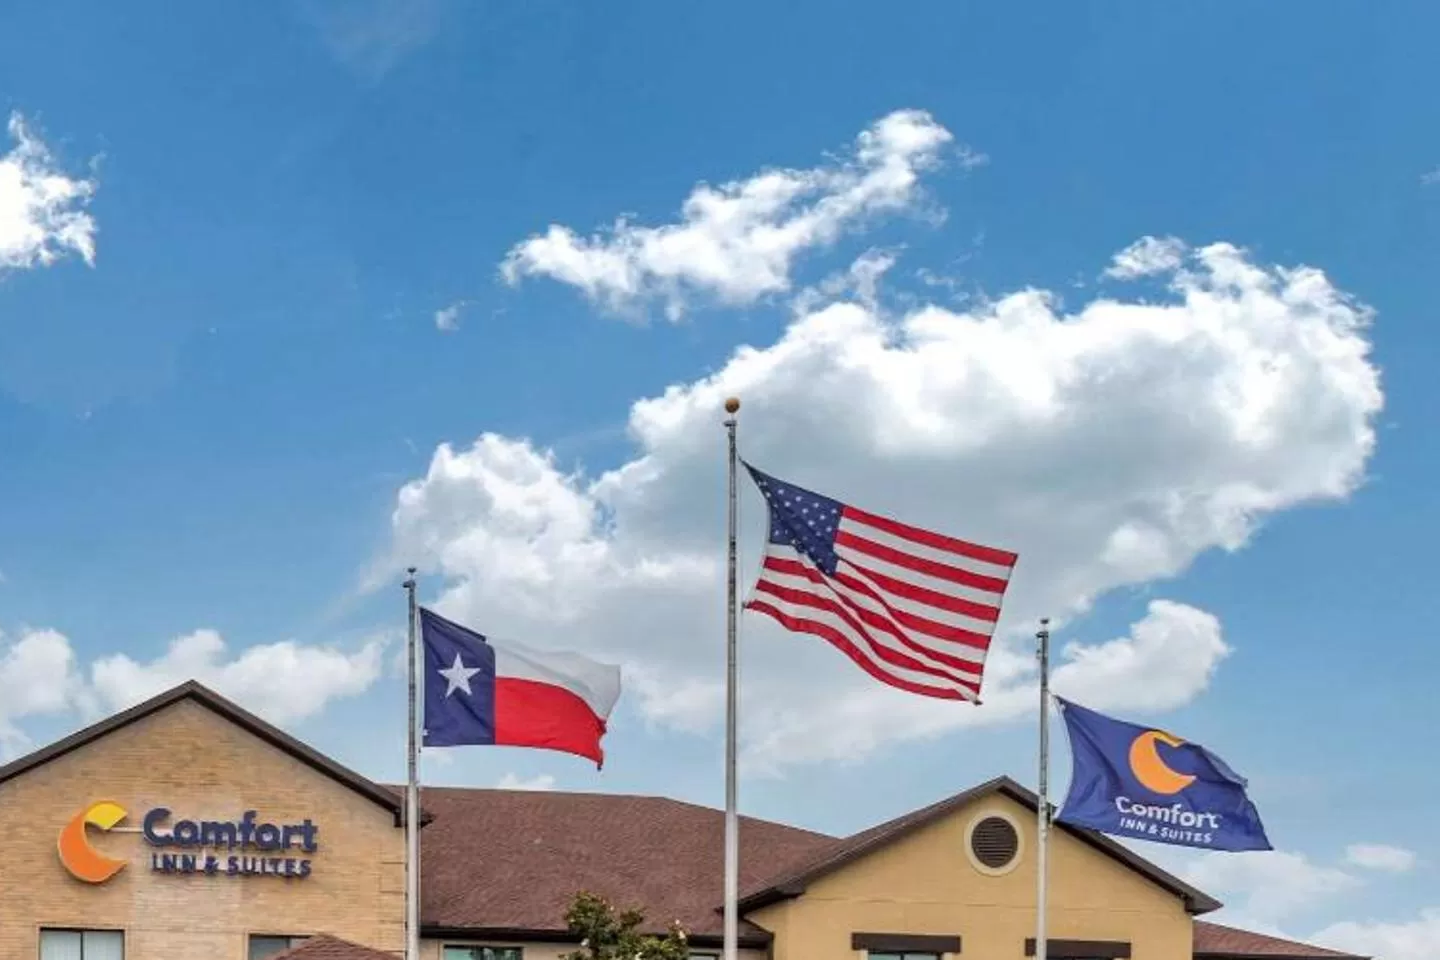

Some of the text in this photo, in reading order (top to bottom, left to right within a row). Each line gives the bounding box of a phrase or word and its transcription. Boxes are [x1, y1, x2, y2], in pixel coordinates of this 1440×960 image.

[1115, 796, 1219, 828] Comfort
[143, 807, 318, 852] Comfort
[1120, 817, 1212, 843] INN & SUITES
[152, 852, 312, 877] INN & SUITES
